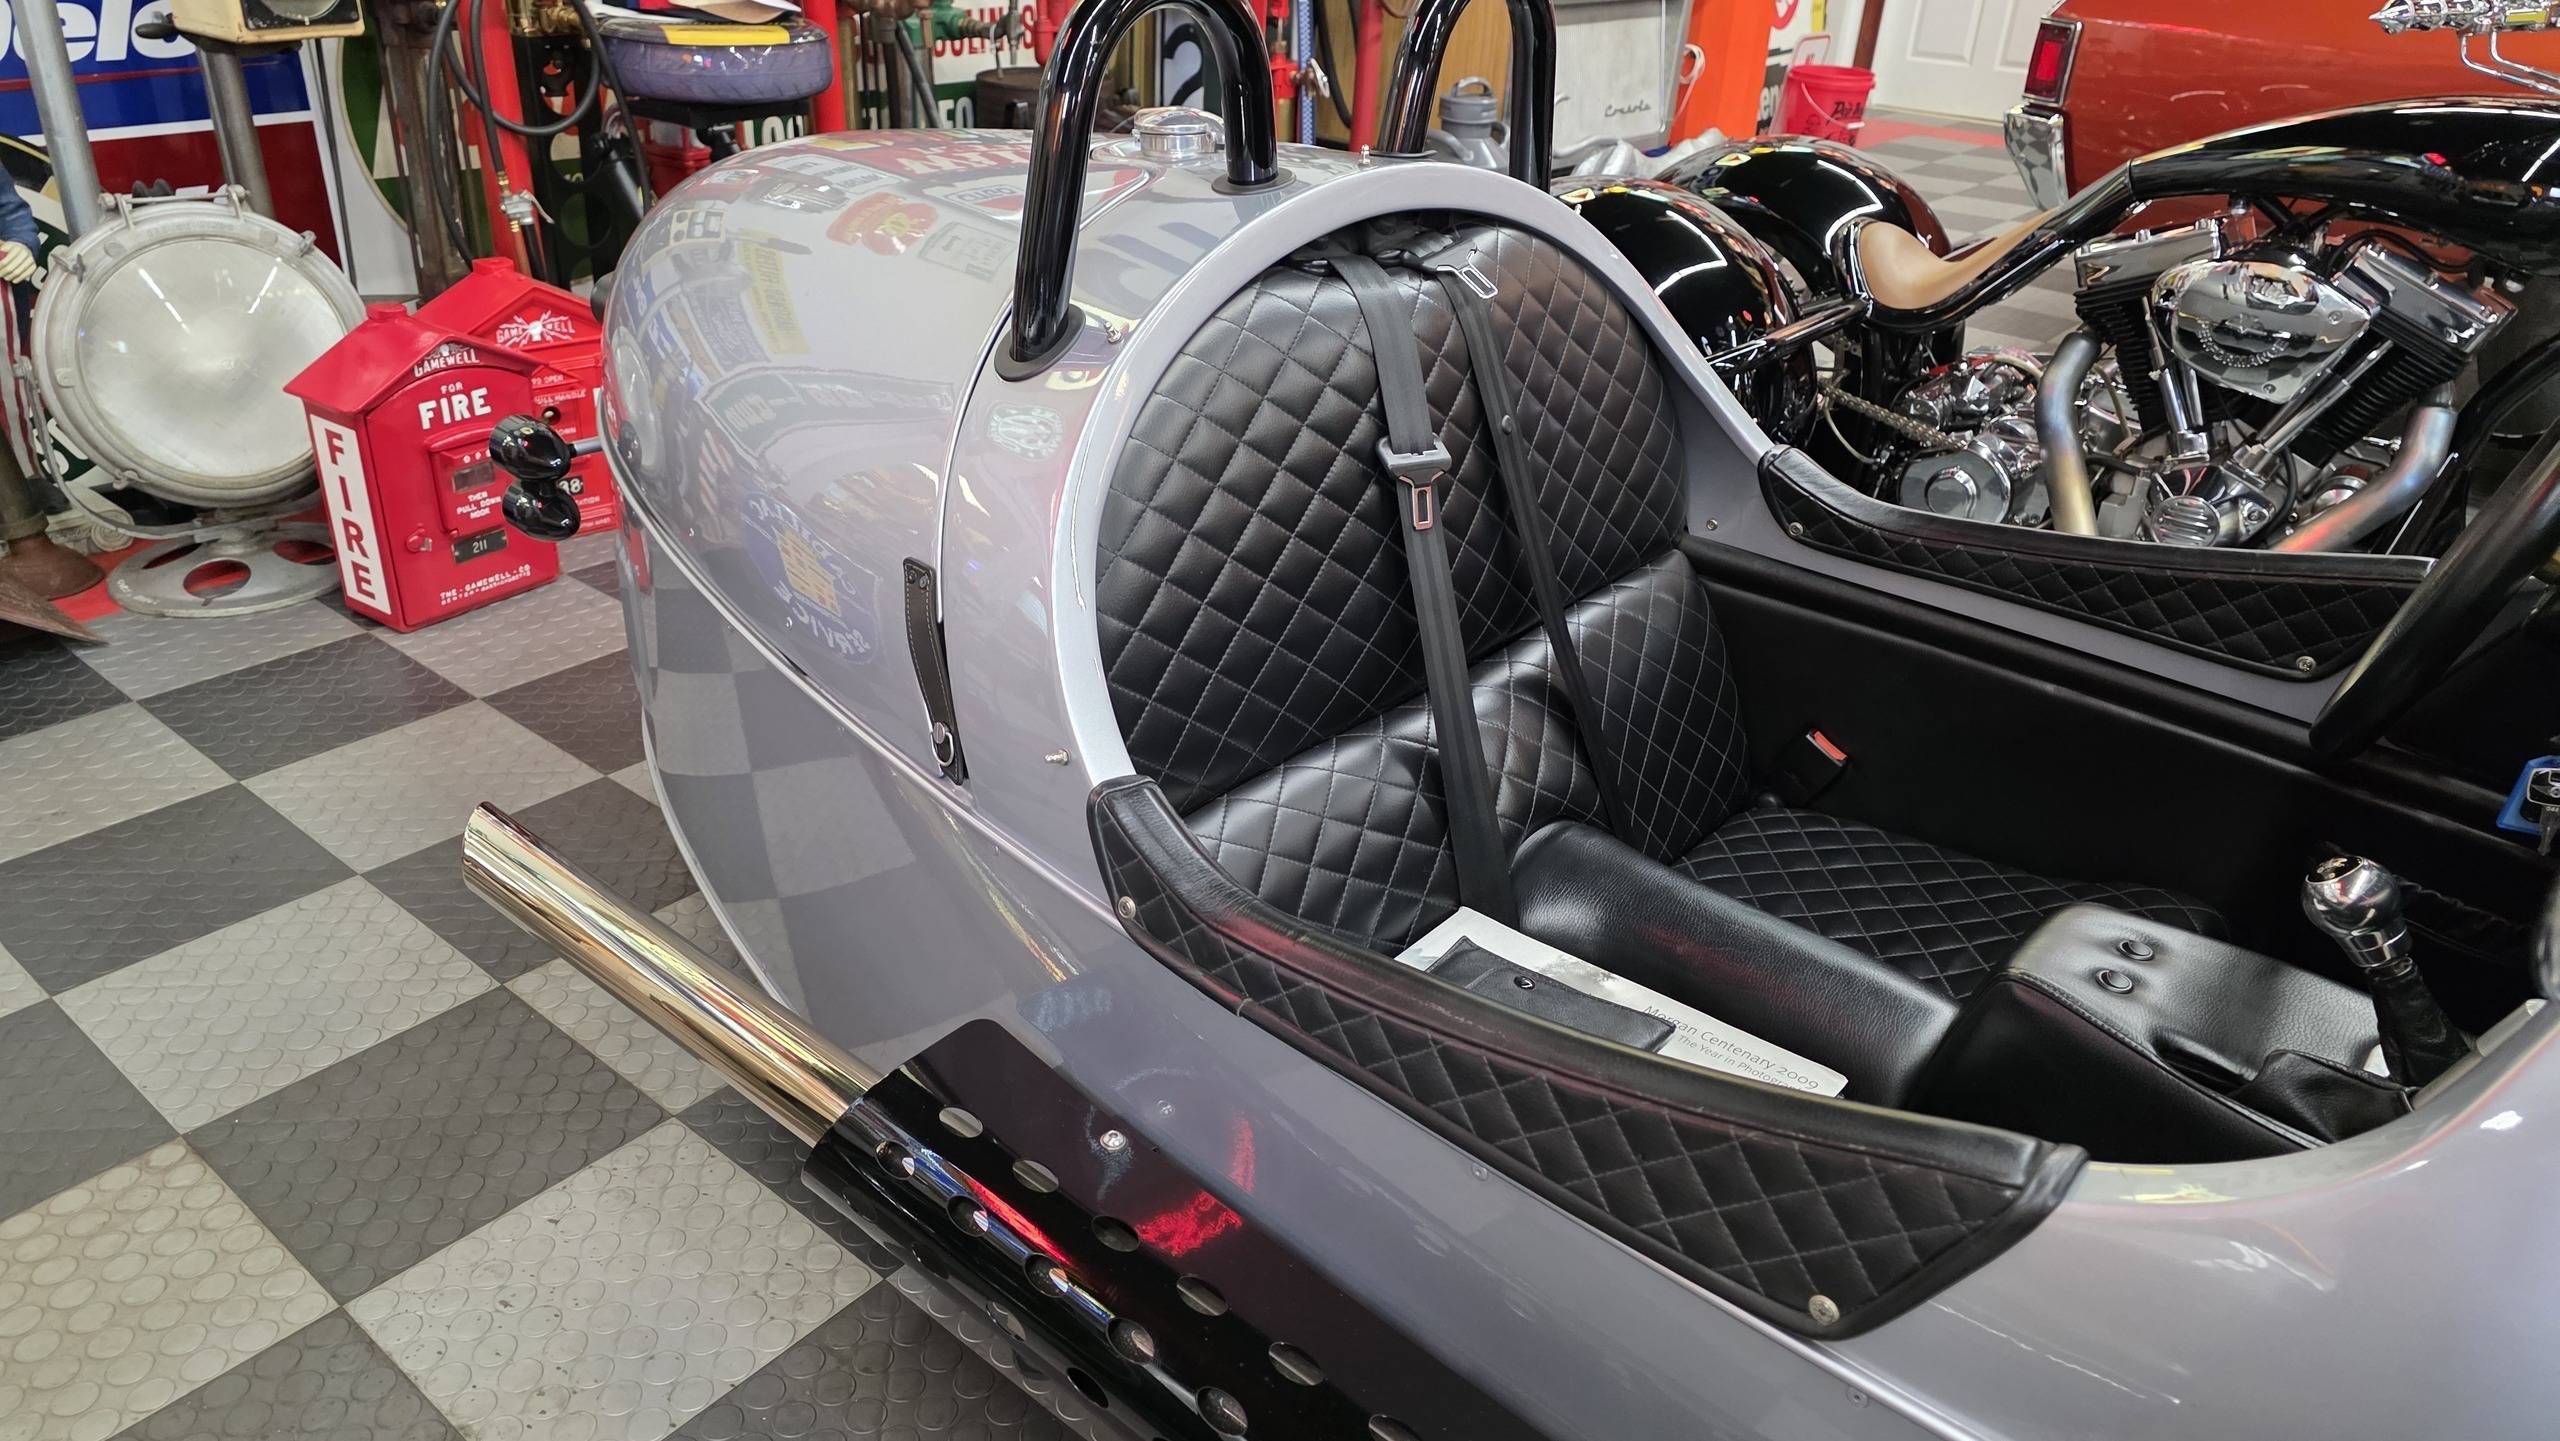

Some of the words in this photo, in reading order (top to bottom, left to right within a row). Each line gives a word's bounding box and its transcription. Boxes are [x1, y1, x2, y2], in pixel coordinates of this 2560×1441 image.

[413, 348, 480, 378] GAMEWELL
[440, 381, 464, 394] FOR
[418, 387, 492, 430] FIRE
[324, 428, 377, 600] FIRE
[456, 504, 477, 515] PULL
[472, 538, 488, 554] 211
[1643, 1006, 1698, 1036] Morgan
[1700, 1031, 1776, 1070] Centenary
[1775, 1066, 1819, 1090] 2009
[1678, 1034, 1698, 1049] The
[1699, 1045, 1724, 1061] Year
[1723, 1056, 1736, 1067] in
